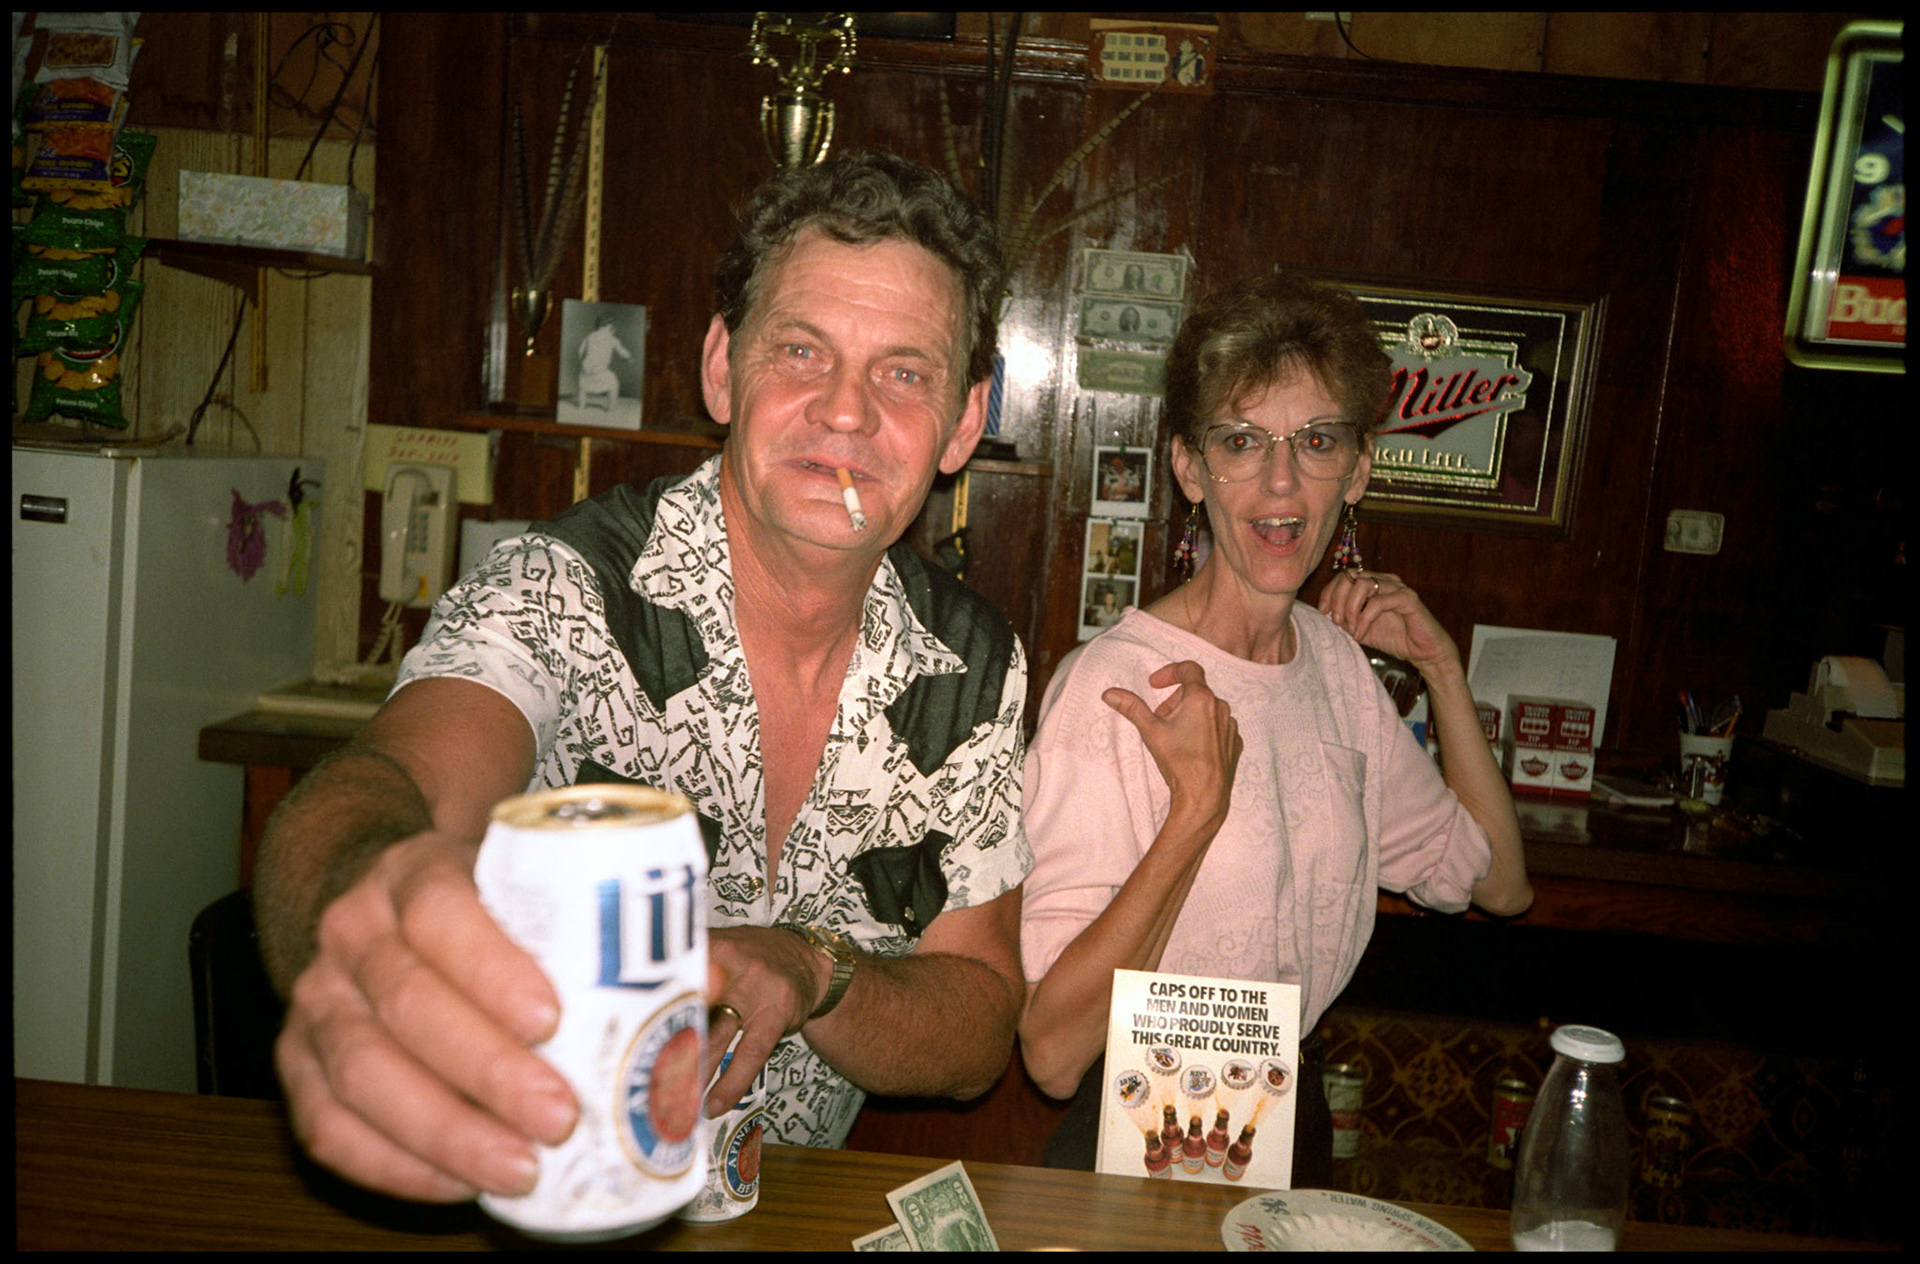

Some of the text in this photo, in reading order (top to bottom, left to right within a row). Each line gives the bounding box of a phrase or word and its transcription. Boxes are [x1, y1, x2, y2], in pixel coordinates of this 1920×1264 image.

[1854, 153, 1891, 185] 9
[1378, 366, 1519, 419] Miller
[1149, 982, 1268, 1006] CAPS OFF TO THE
[1146, 998, 1268, 1022] MEN AND WOMEN
[1132, 1013, 1280, 1040] WHO PROUDLY SERVE
[1131, 1030, 1281, 1057] THIS GREAT COUNTRY.
[1119, 1074, 1138, 1087] ARMY
[728, 1125, 751, 1168] A FINE
[1330, 1192, 1367, 1208] WATER
[1371, 1201, 1414, 1222] SPRING
